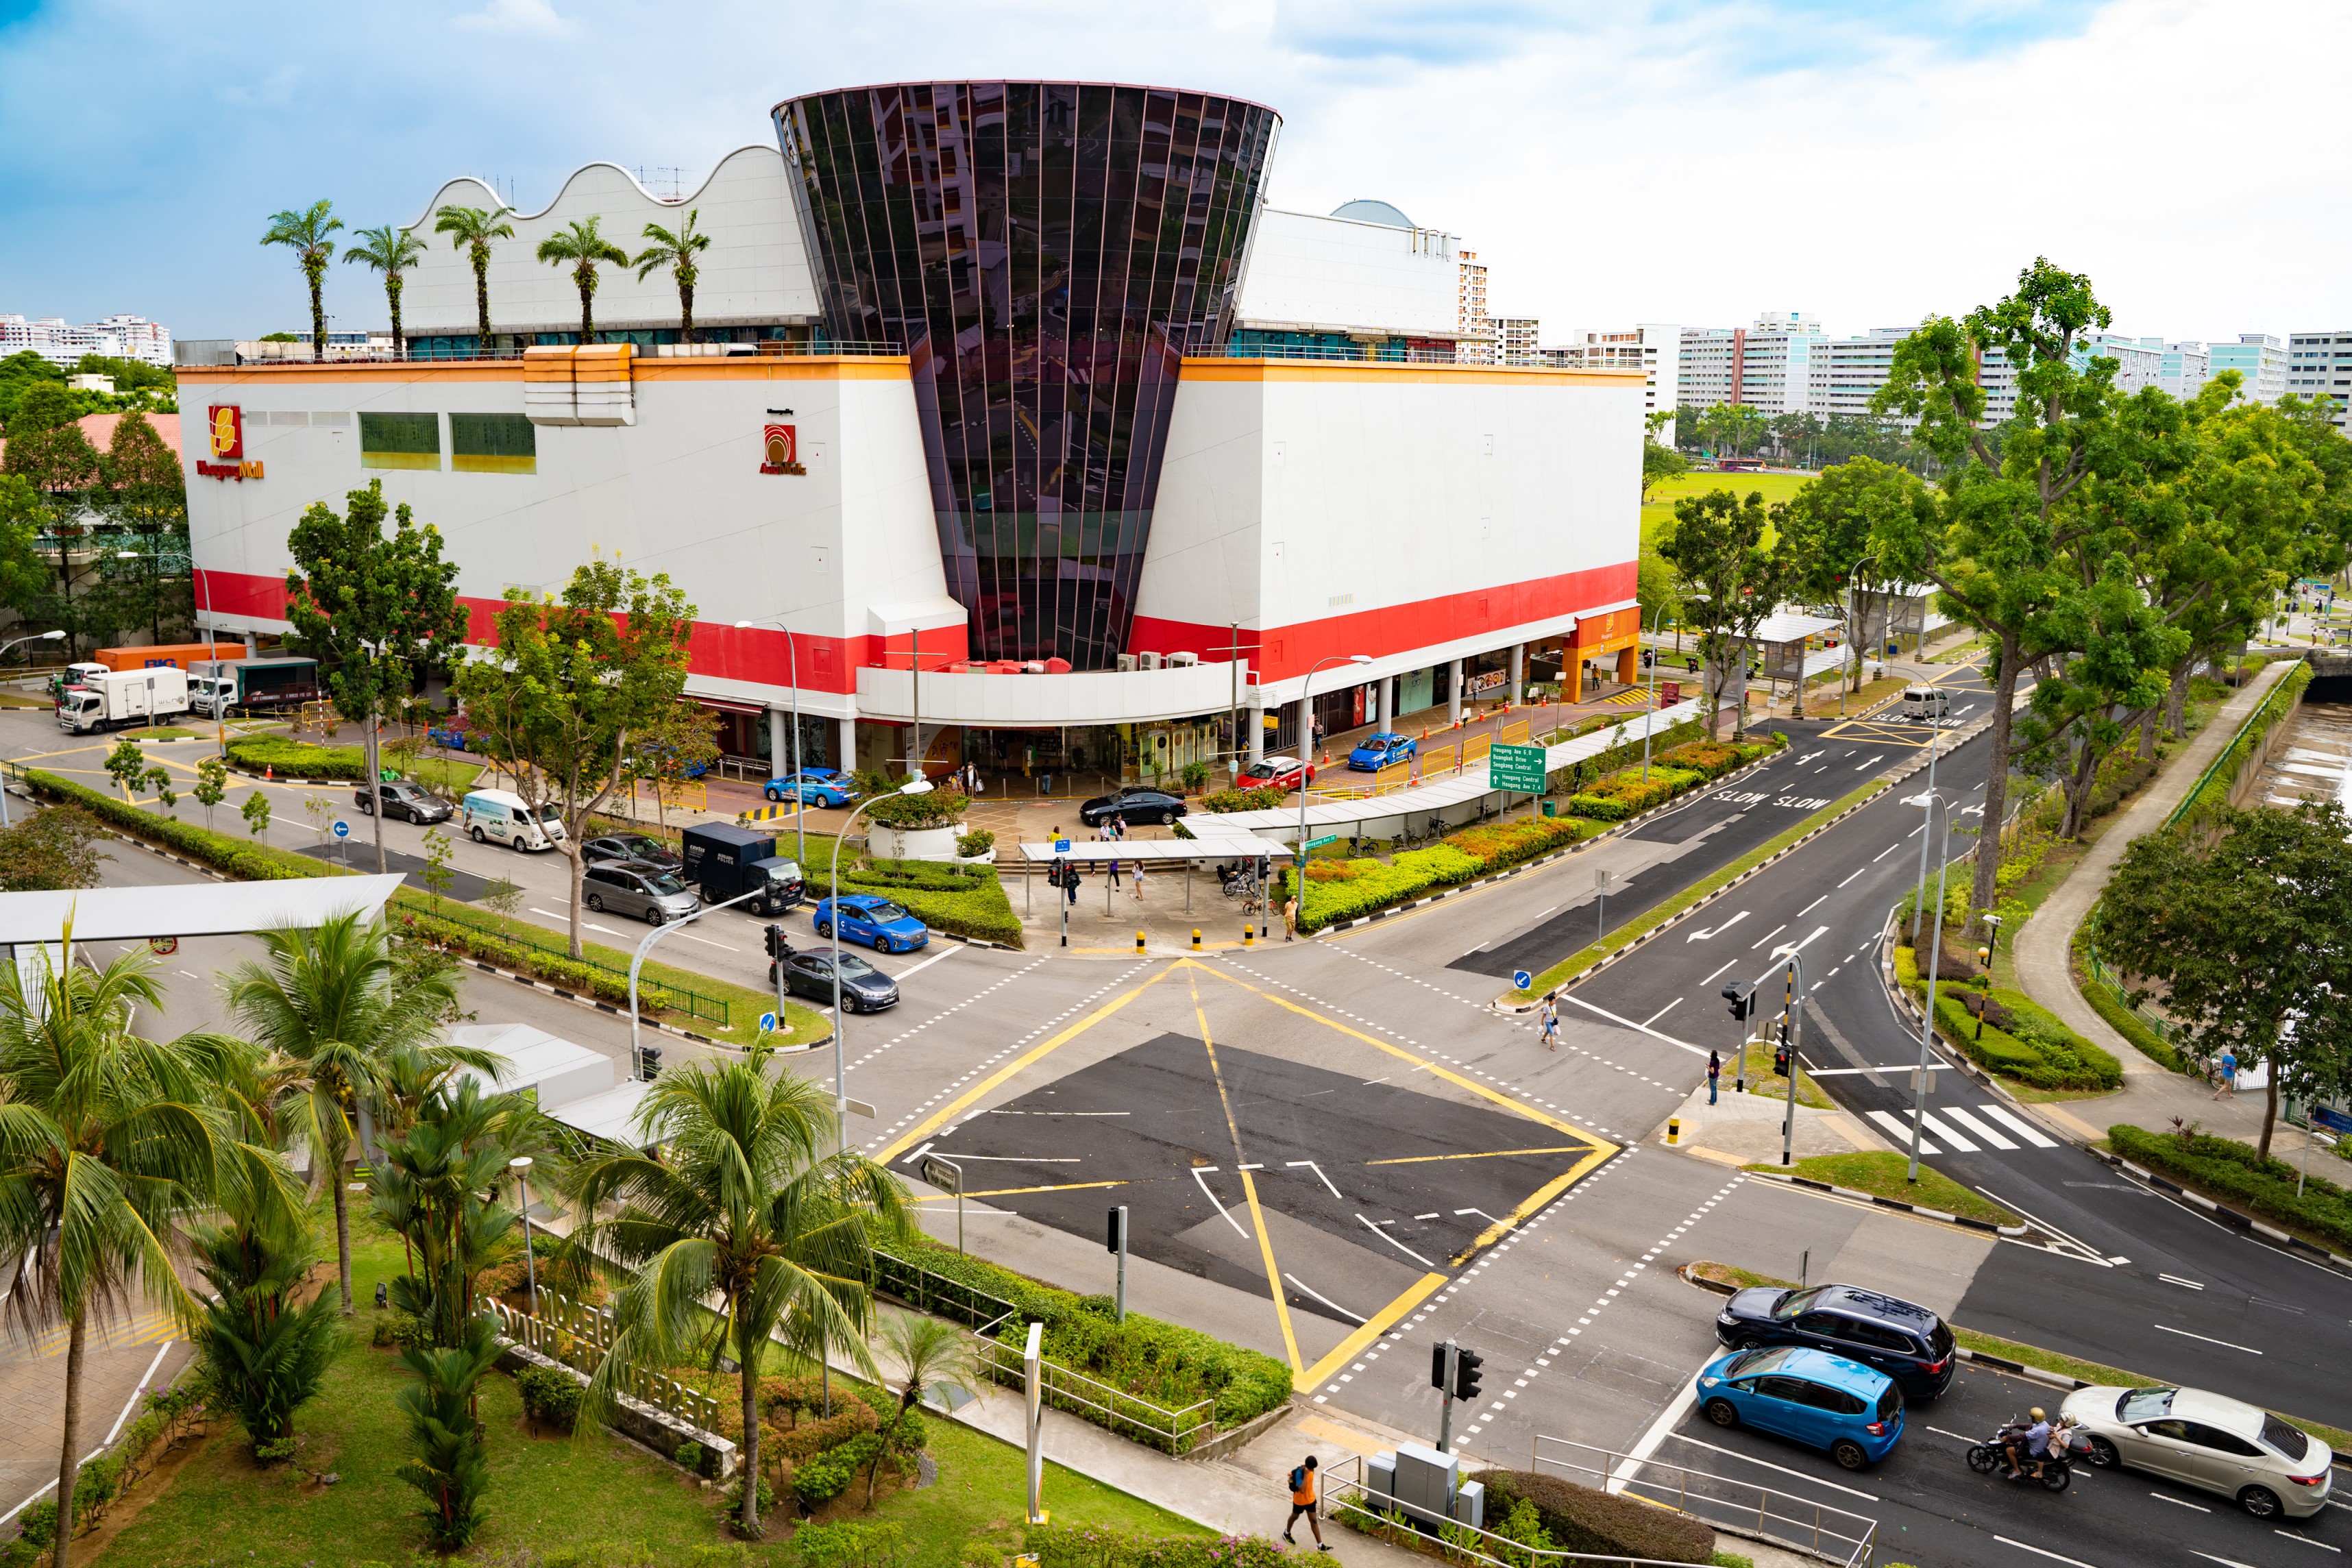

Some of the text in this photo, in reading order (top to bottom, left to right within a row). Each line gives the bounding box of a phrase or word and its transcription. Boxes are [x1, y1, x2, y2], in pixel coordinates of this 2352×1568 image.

[1872, 713, 1966, 726] SLOW SLOW
[1493, 761, 1513, 770] Sengkang
[1502, 781, 1521, 789] Hougang
[1712, 790, 1831, 810] SLOW SLOW
[717, 856, 734, 865] POLICE
[2328, 1117, 2352, 1130] Community
[928, 1163, 936, 1173] Holy
[931, 1174, 952, 1190] High School
